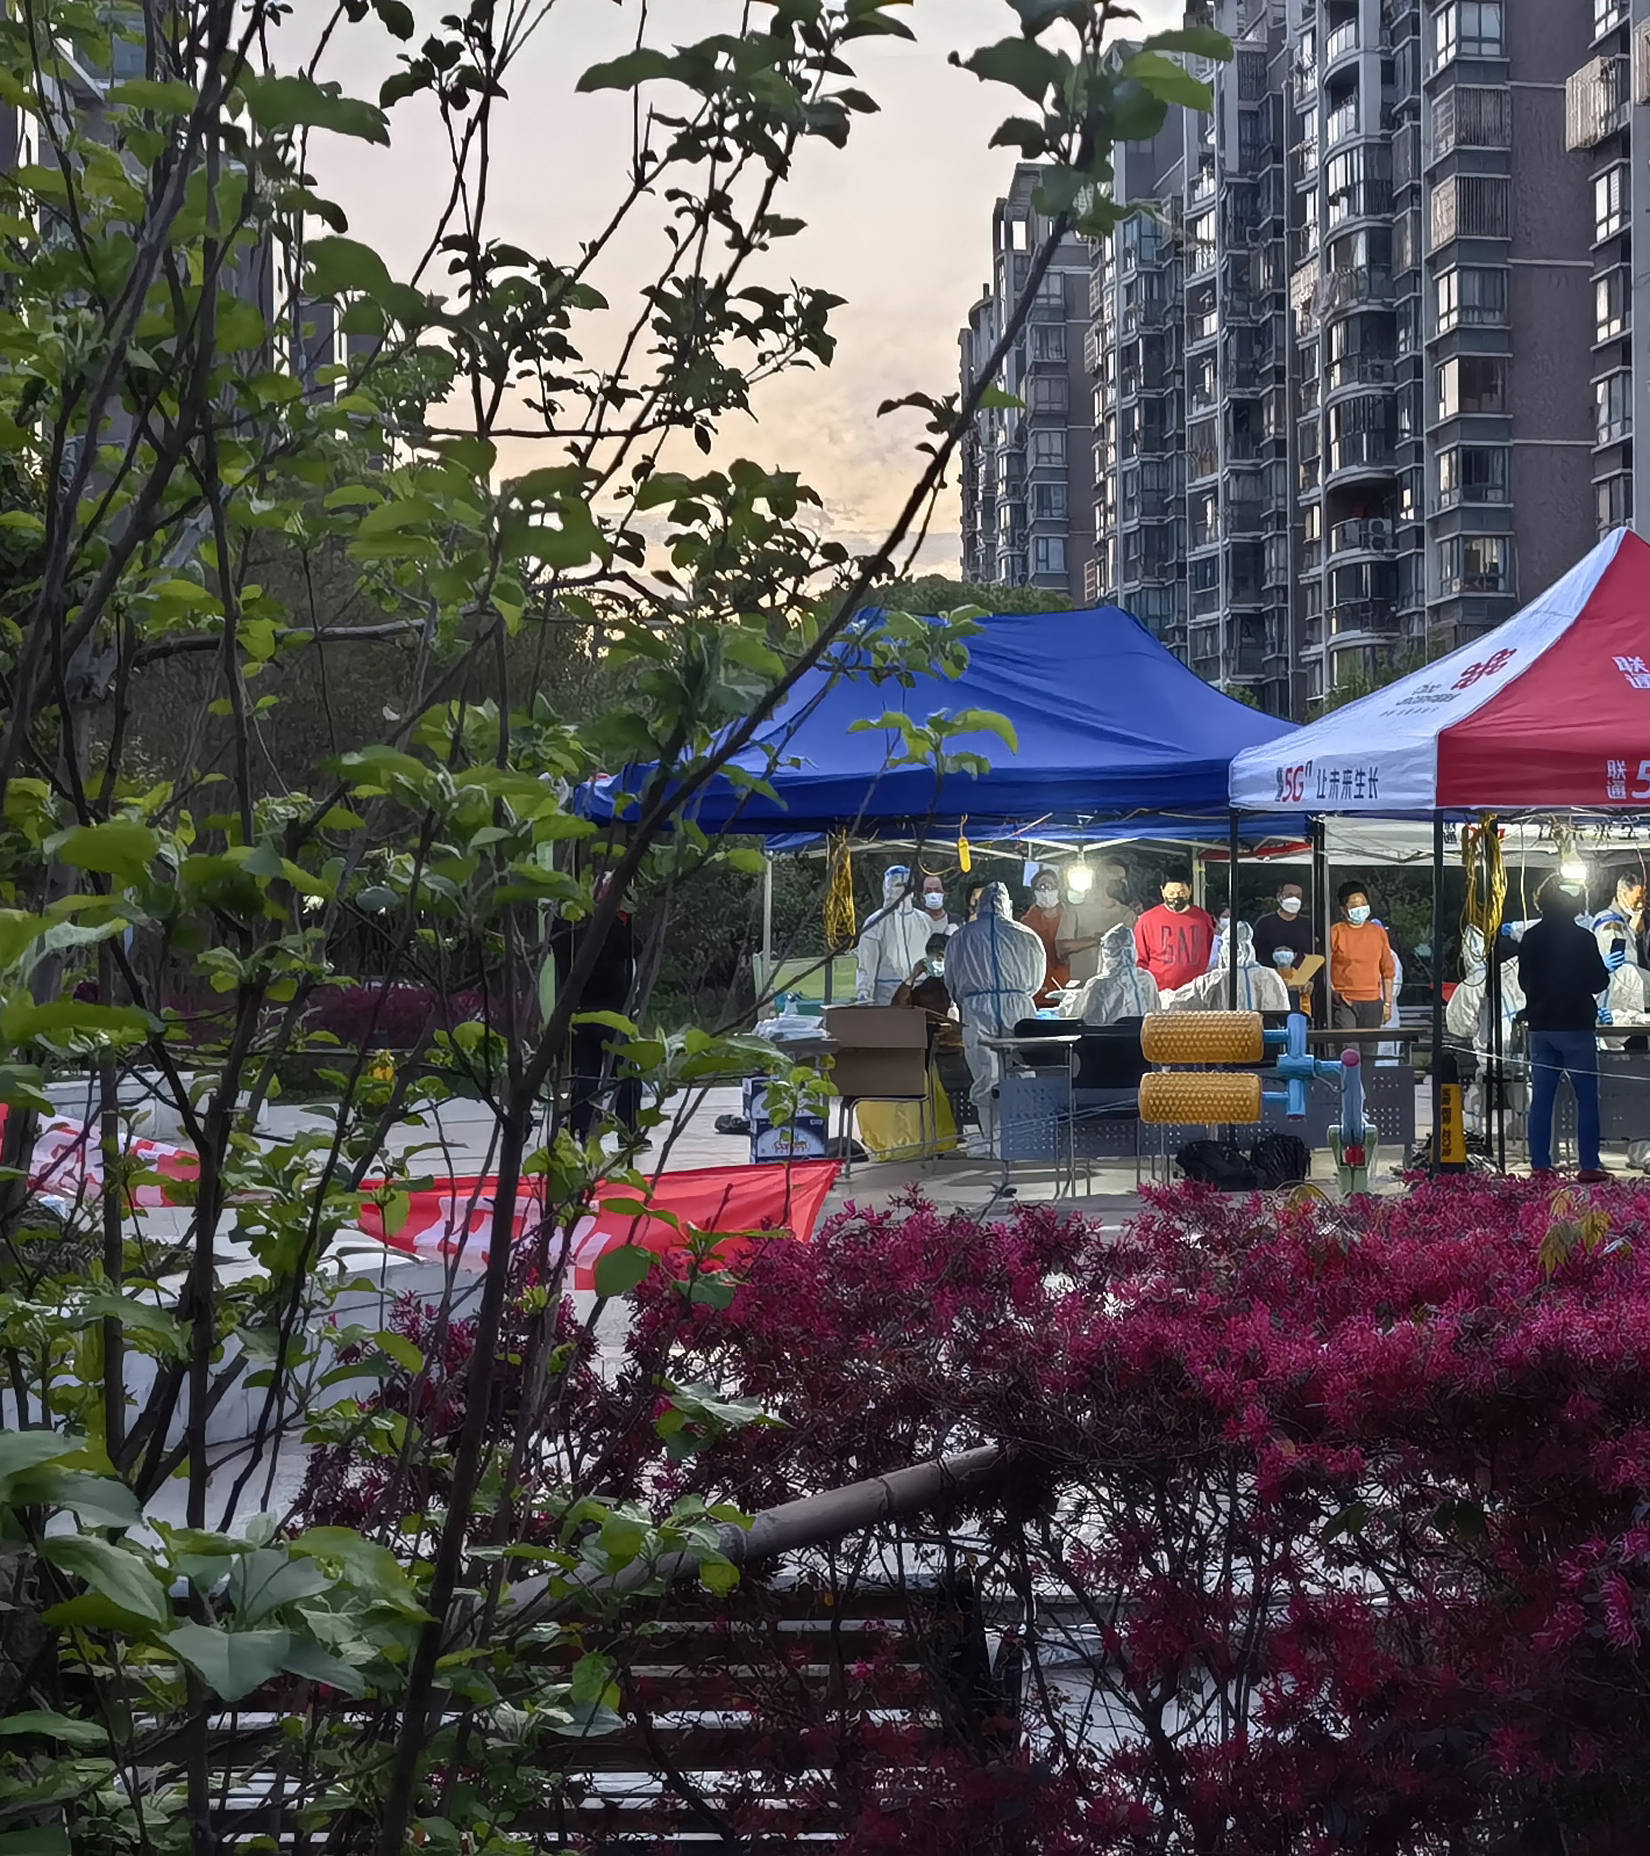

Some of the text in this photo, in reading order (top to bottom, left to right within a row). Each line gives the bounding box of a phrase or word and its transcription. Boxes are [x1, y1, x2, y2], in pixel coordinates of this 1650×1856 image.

[1316, 767, 1379, 800] 让未来生长
